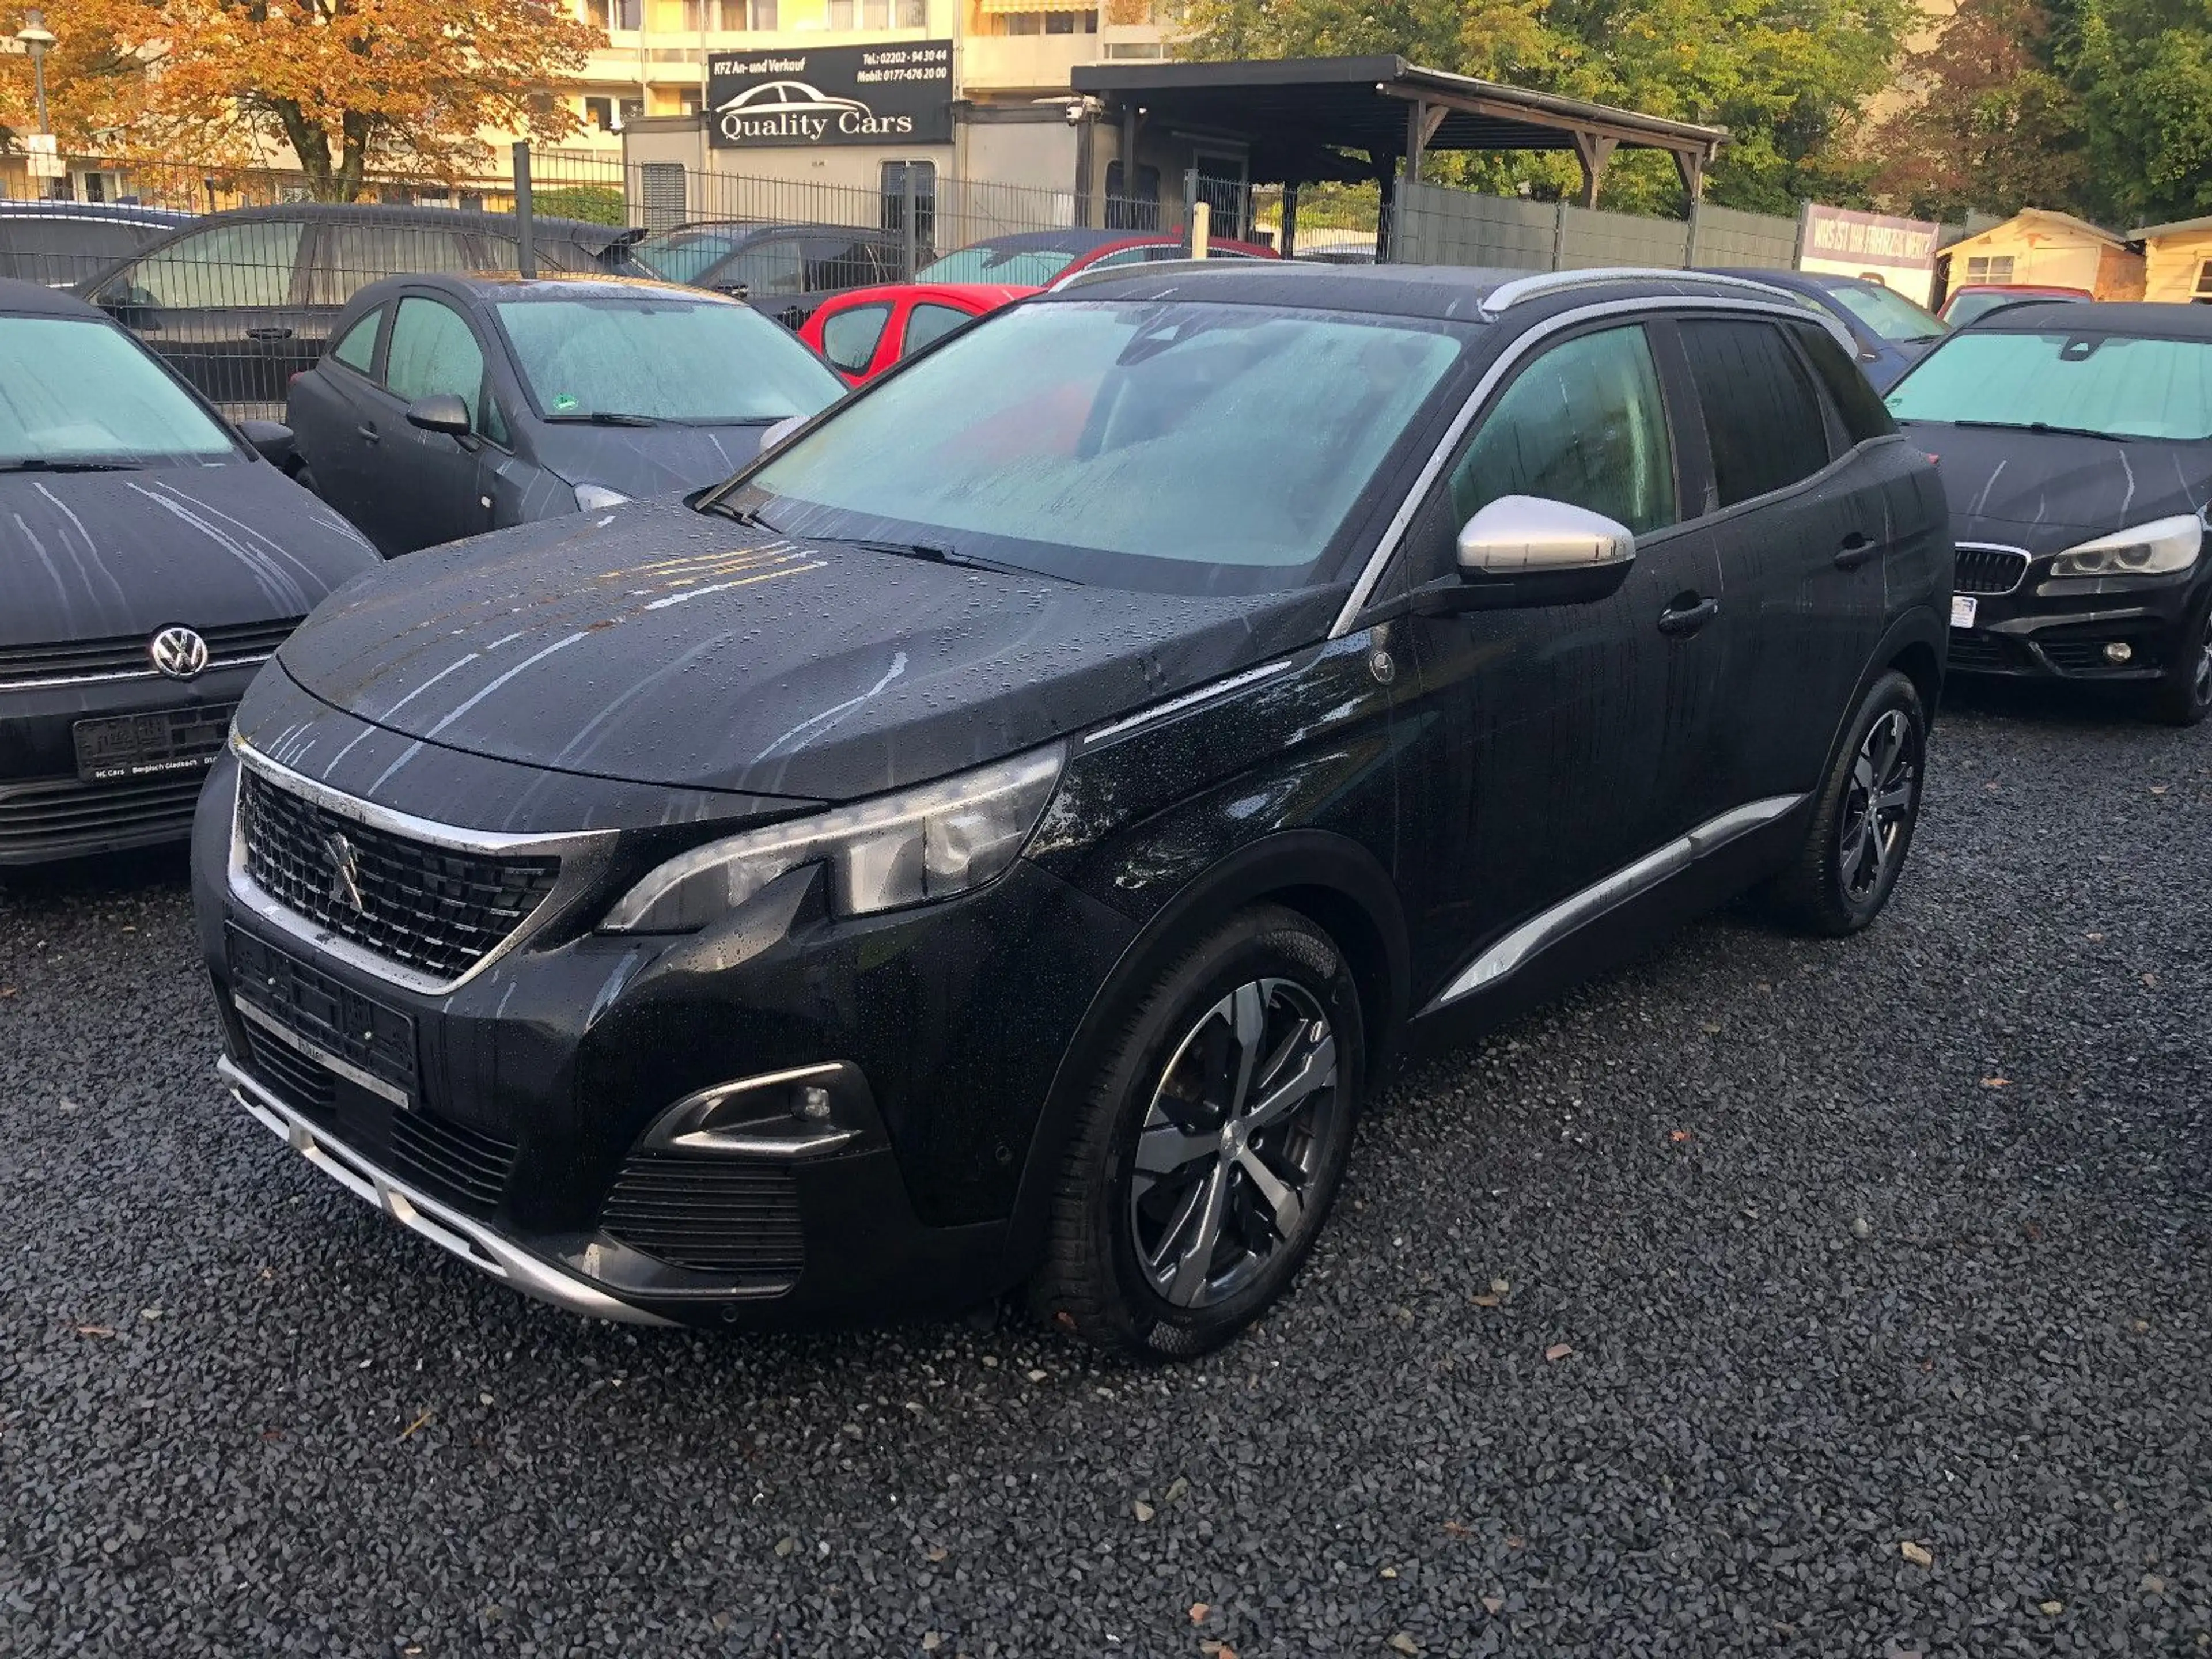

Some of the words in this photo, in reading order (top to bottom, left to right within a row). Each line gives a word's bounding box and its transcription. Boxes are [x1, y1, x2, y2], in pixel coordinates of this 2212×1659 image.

[714, 61, 732, 75] KFZ
[732, 61, 748, 74] An-
[749, 59, 767, 73] und
[768, 56, 806, 72] Verkauf
[880, 51, 906, 64] 02202
[912, 51, 923, 62] 94
[923, 50, 935, 62] 30
[936, 50, 947, 61] 44
[857, 69, 882, 82] Mobil:
[923, 67, 934, 79] 20
[935, 67, 947, 79] 00
[721, 113, 828, 141] Quality
[839, 111, 912, 134] Cars
[1814, 217, 1835, 249] WAS
